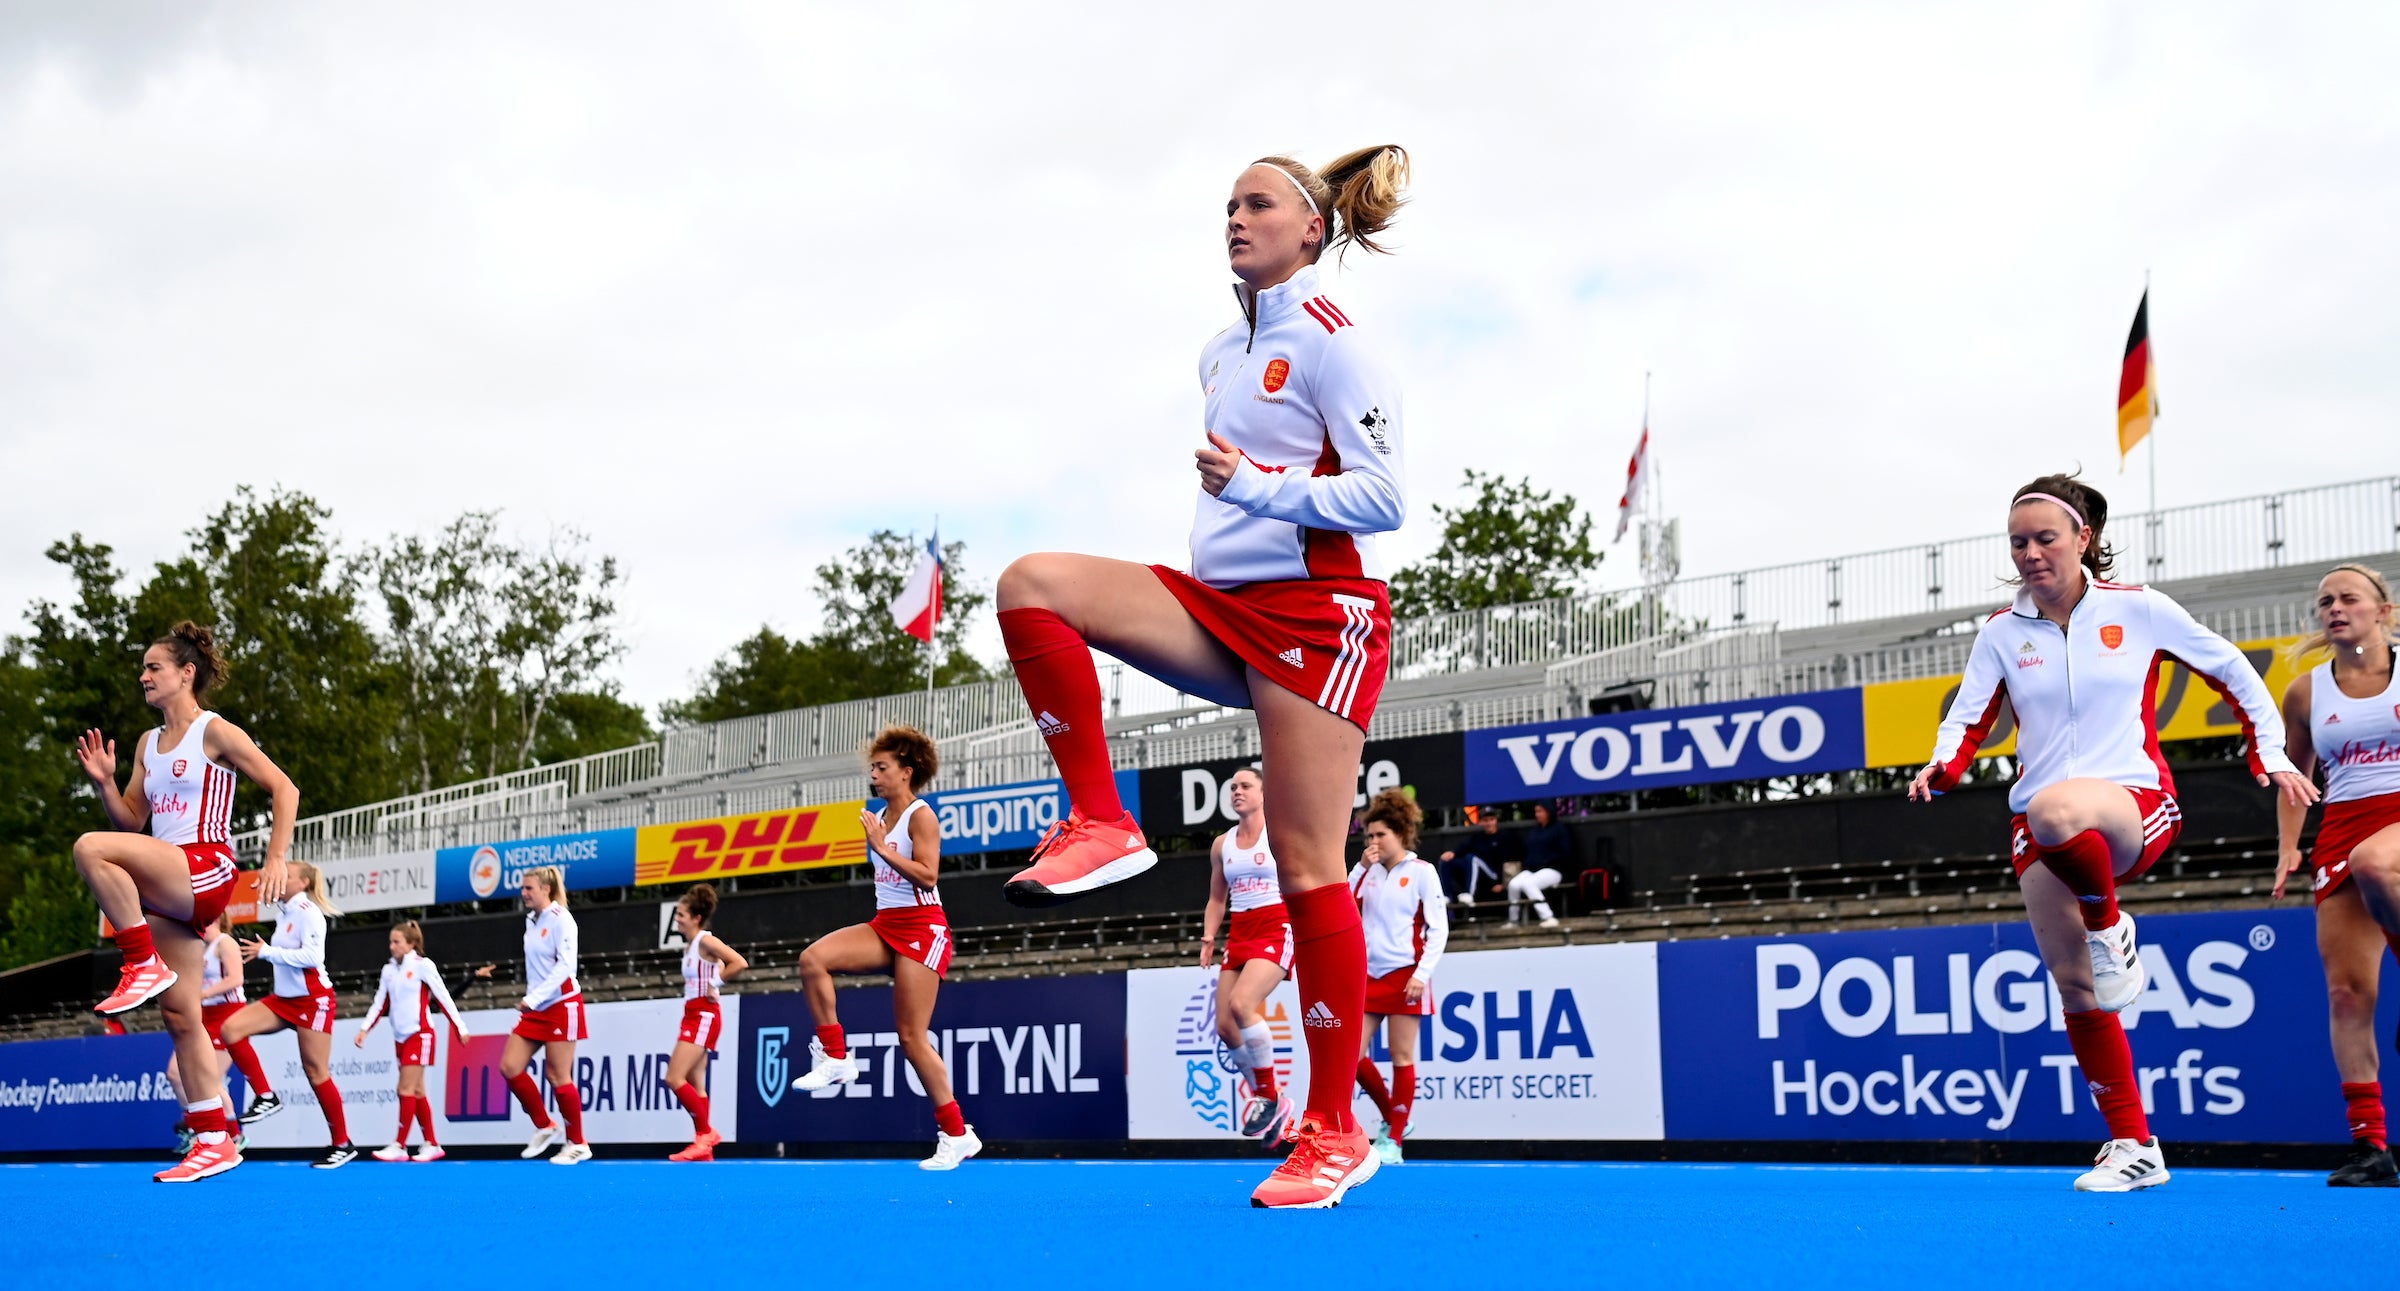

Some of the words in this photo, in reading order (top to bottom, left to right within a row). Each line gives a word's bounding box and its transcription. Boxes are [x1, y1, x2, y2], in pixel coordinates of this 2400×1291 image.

[1253, 394, 1284, 405] ENGLAND
[1278, 652, 1305, 669] adidas
[1040, 722, 1071, 737] das
[1497, 705, 1826, 786] VOLVO
[2329, 739, 2400, 767] Vitali
[149, 792, 188, 820] tality
[938, 795, 1060, 846] auping
[503, 839, 599, 868] NEDERLANDSE
[668, 811, 831, 876] DHL
[325, 866, 429, 899] YDIRECT.NL
[1756, 924, 2276, 1039] POLIGAS®
[1304, 1015, 1342, 1029] adidas
[1371, 988, 1595, 1062] ISHA
[48, 1073, 137, 1105] Foundation
[138, 1072, 153, 1101] &
[522, 1056, 615, 1114] IBA
[626, 1050, 720, 1111] MRT
[1413, 1076, 1446, 1100] EST
[1454, 1075, 1504, 1099] KEPT
[1511, 1074, 1597, 1099] SECRET.
[1772, 1054, 2029, 1131] Hockey
[2040, 1048, 2246, 1116] Trfs
